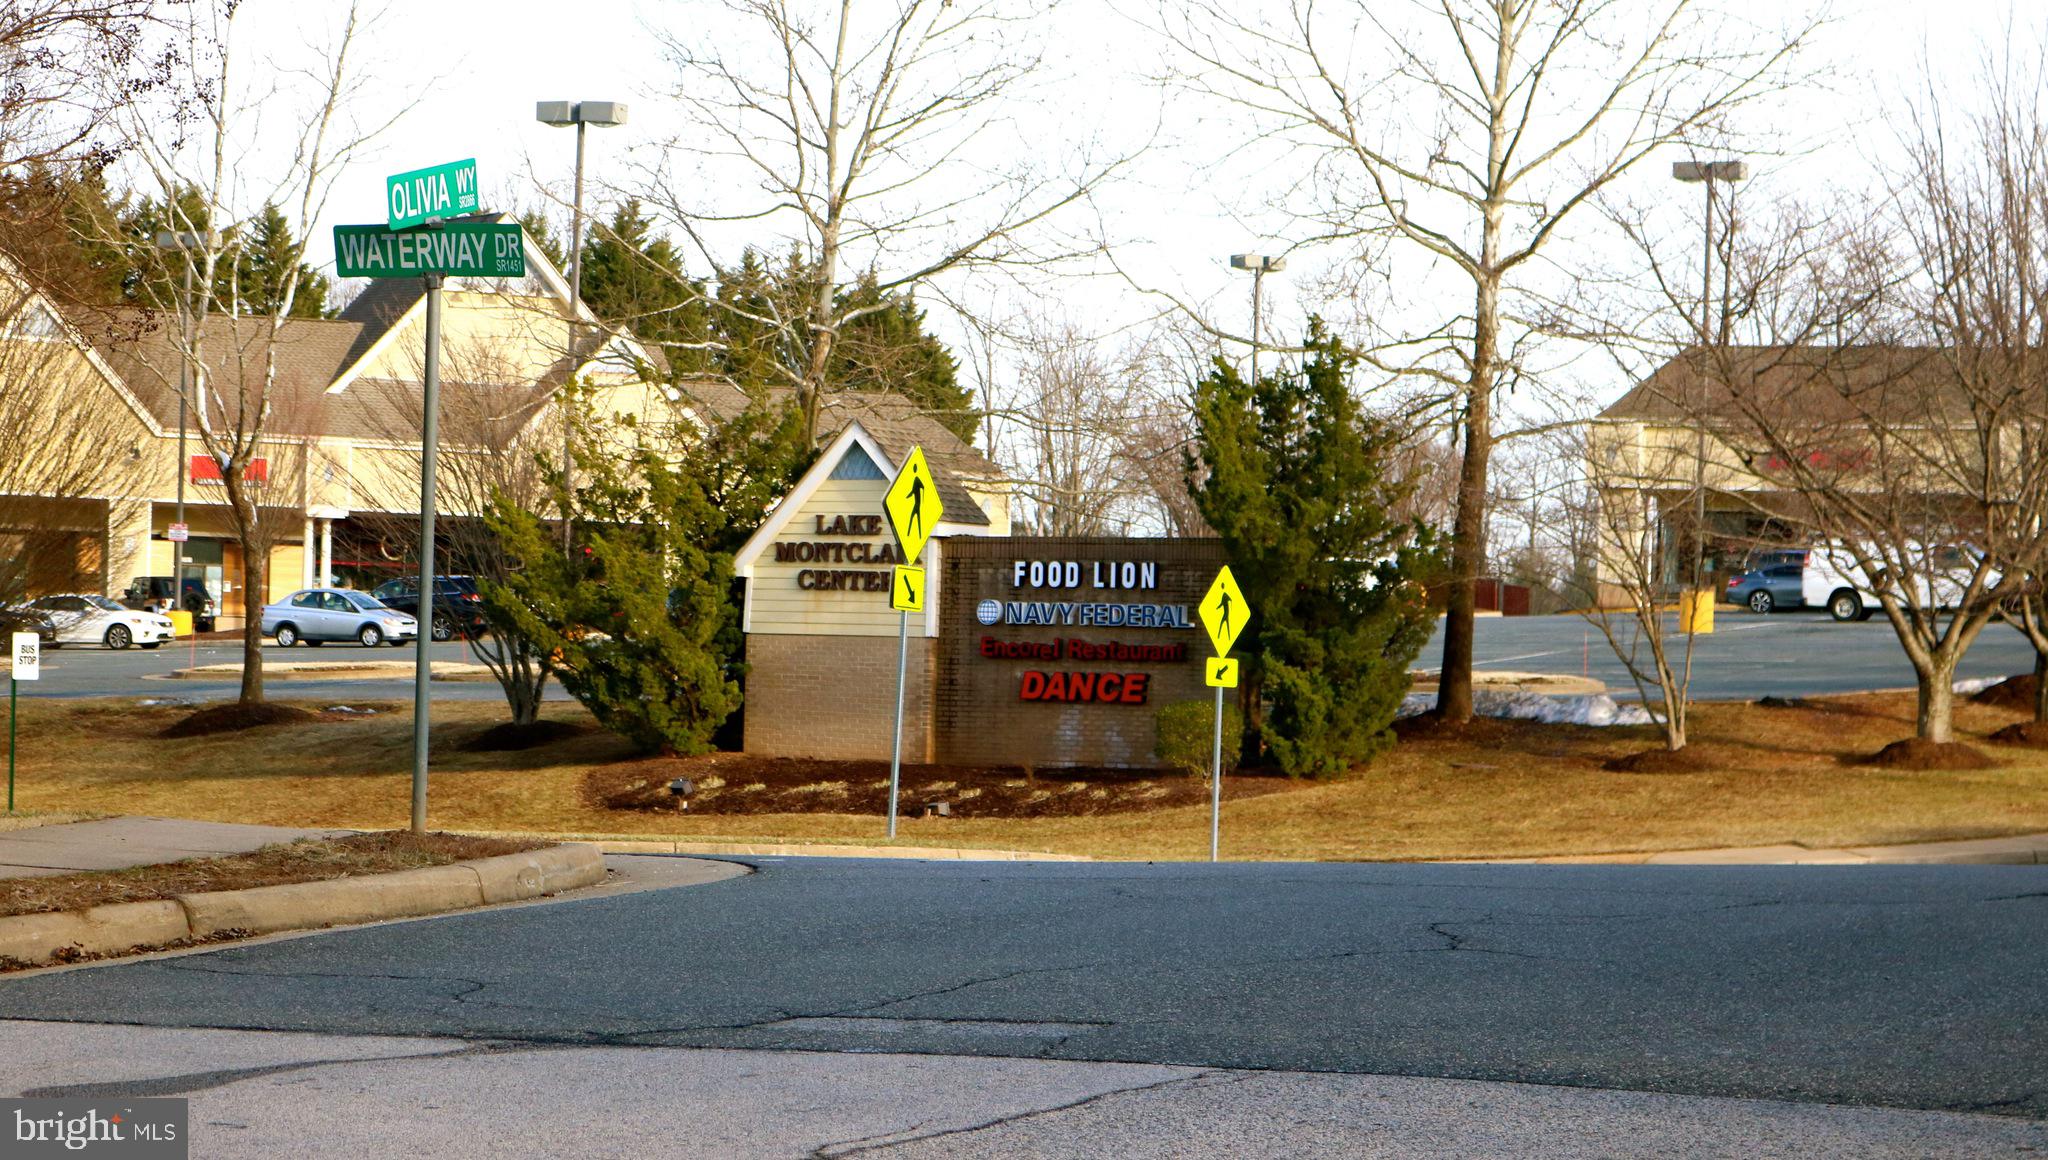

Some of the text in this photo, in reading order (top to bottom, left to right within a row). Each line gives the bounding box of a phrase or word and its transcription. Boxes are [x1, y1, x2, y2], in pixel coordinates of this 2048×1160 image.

[391, 166, 475, 220] OLIVIA WY
[340, 233, 521, 269] WATERWAY DR
[496, 259, 522, 272] SR1451
[815, 514, 883, 536] LAKE
[774, 541, 923, 565] MONTCLAI
[1013, 560, 1157, 589] FOOD LION
[1005, 602, 1195, 629] NAVY FEDERAL
[19, 655, 37, 665] STOP
[21, 644, 35, 654] BUS
[980, 636, 1188, 662] Encorel Restaurant
[1020, 671, 1148, 703] DANCE
